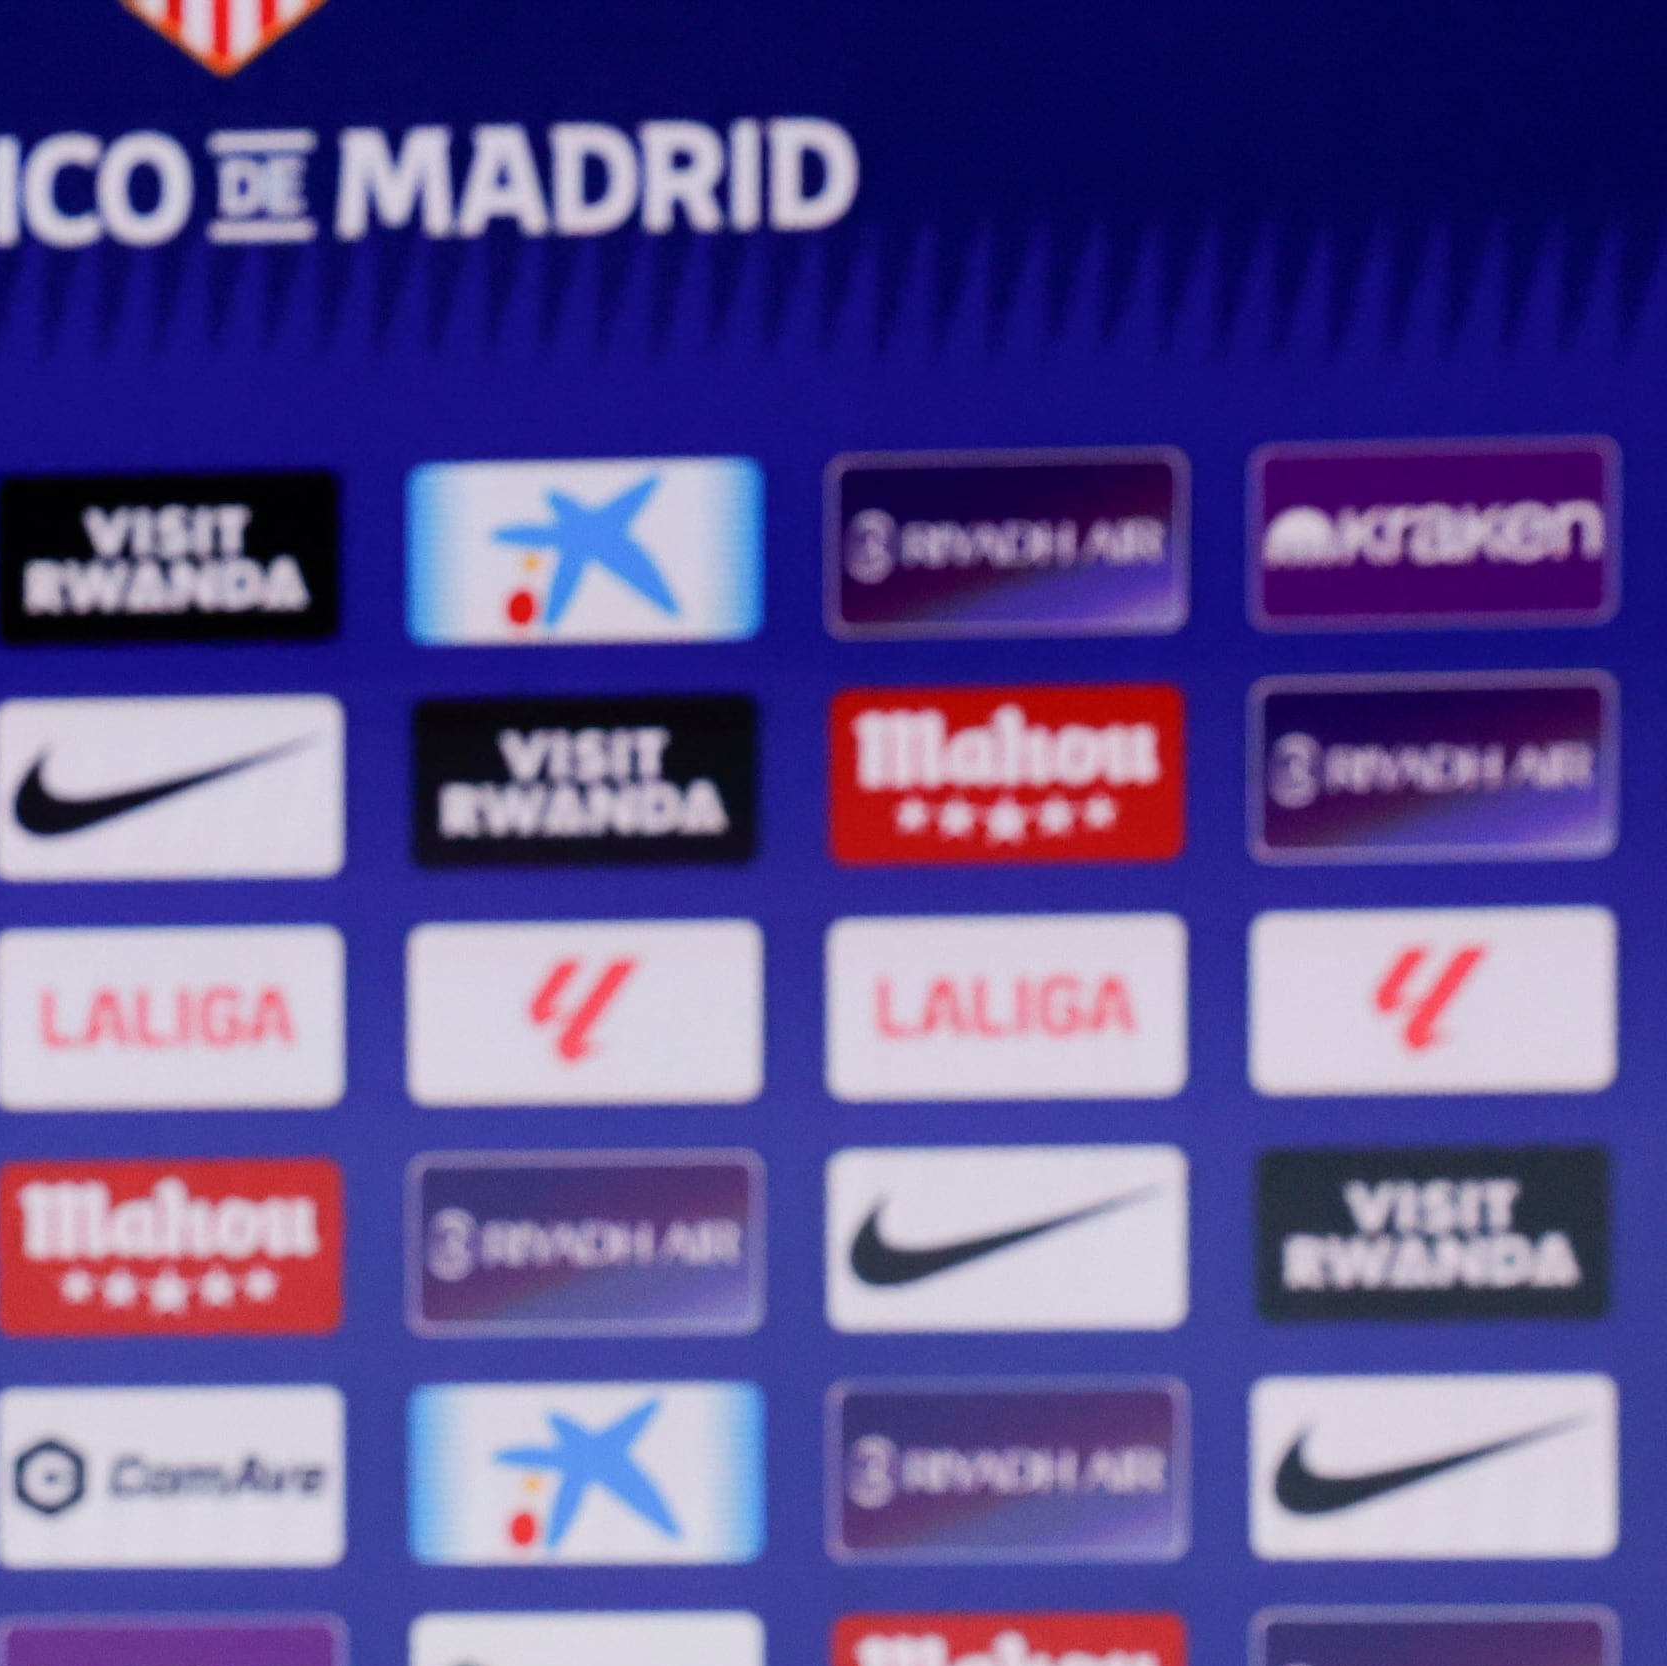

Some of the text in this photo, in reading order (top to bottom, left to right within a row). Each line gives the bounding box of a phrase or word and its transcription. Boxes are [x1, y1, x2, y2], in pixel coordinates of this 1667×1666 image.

[219, 159, 309, 213] DE
[334, 117, 861, 240] MADRID
[84, 505, 249, 554] VISIT
[24, 555, 308, 613] RWANDA
[500, 728, 668, 781] VISIT
[855, 706, 1159, 789] Mahou
[439, 781, 727, 837] RWANDA
[40, 985, 295, 1050] LALIGA
[875, 974, 1137, 1040] LALIGA
[20, 1178, 318, 1260] Mahou
[1345, 1179, 1519, 1232] VISIT
[1283, 1233, 1579, 1289] RWANDA
